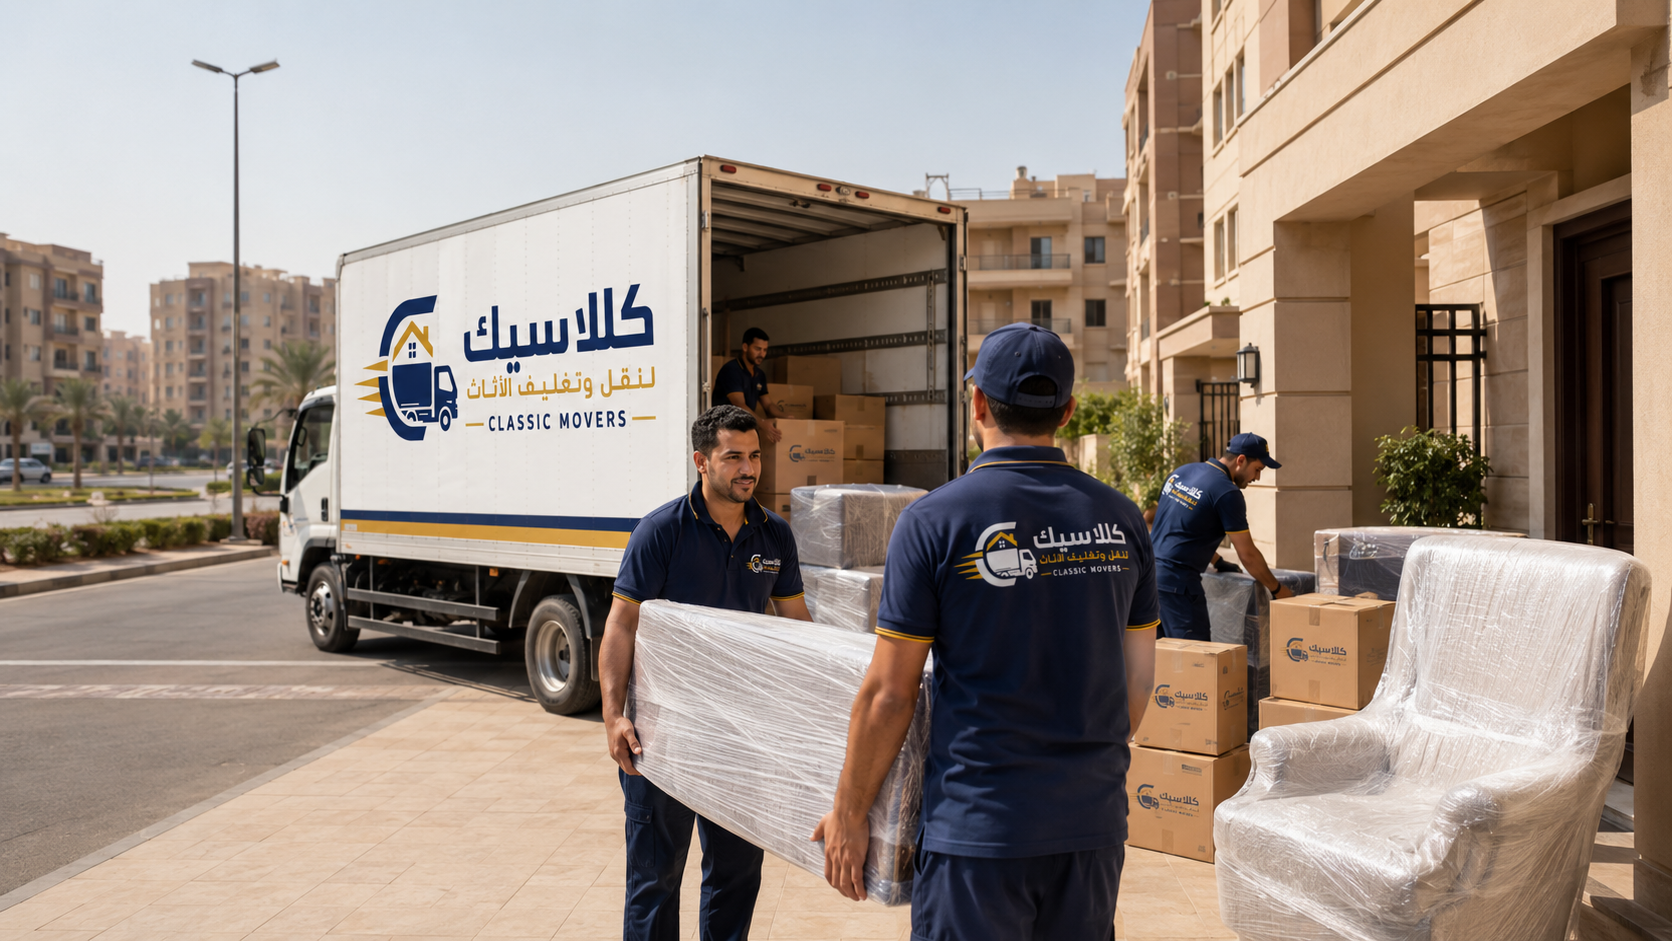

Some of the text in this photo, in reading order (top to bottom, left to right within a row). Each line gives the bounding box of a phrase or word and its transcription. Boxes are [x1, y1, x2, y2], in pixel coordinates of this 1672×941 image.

[466, 366, 656, 401] لنقل وتغليف الأثاث
[488, 410, 627, 432] CLASSIC MOVERS
[1052, 565, 1122, 577] CLASSIC MOVERS
